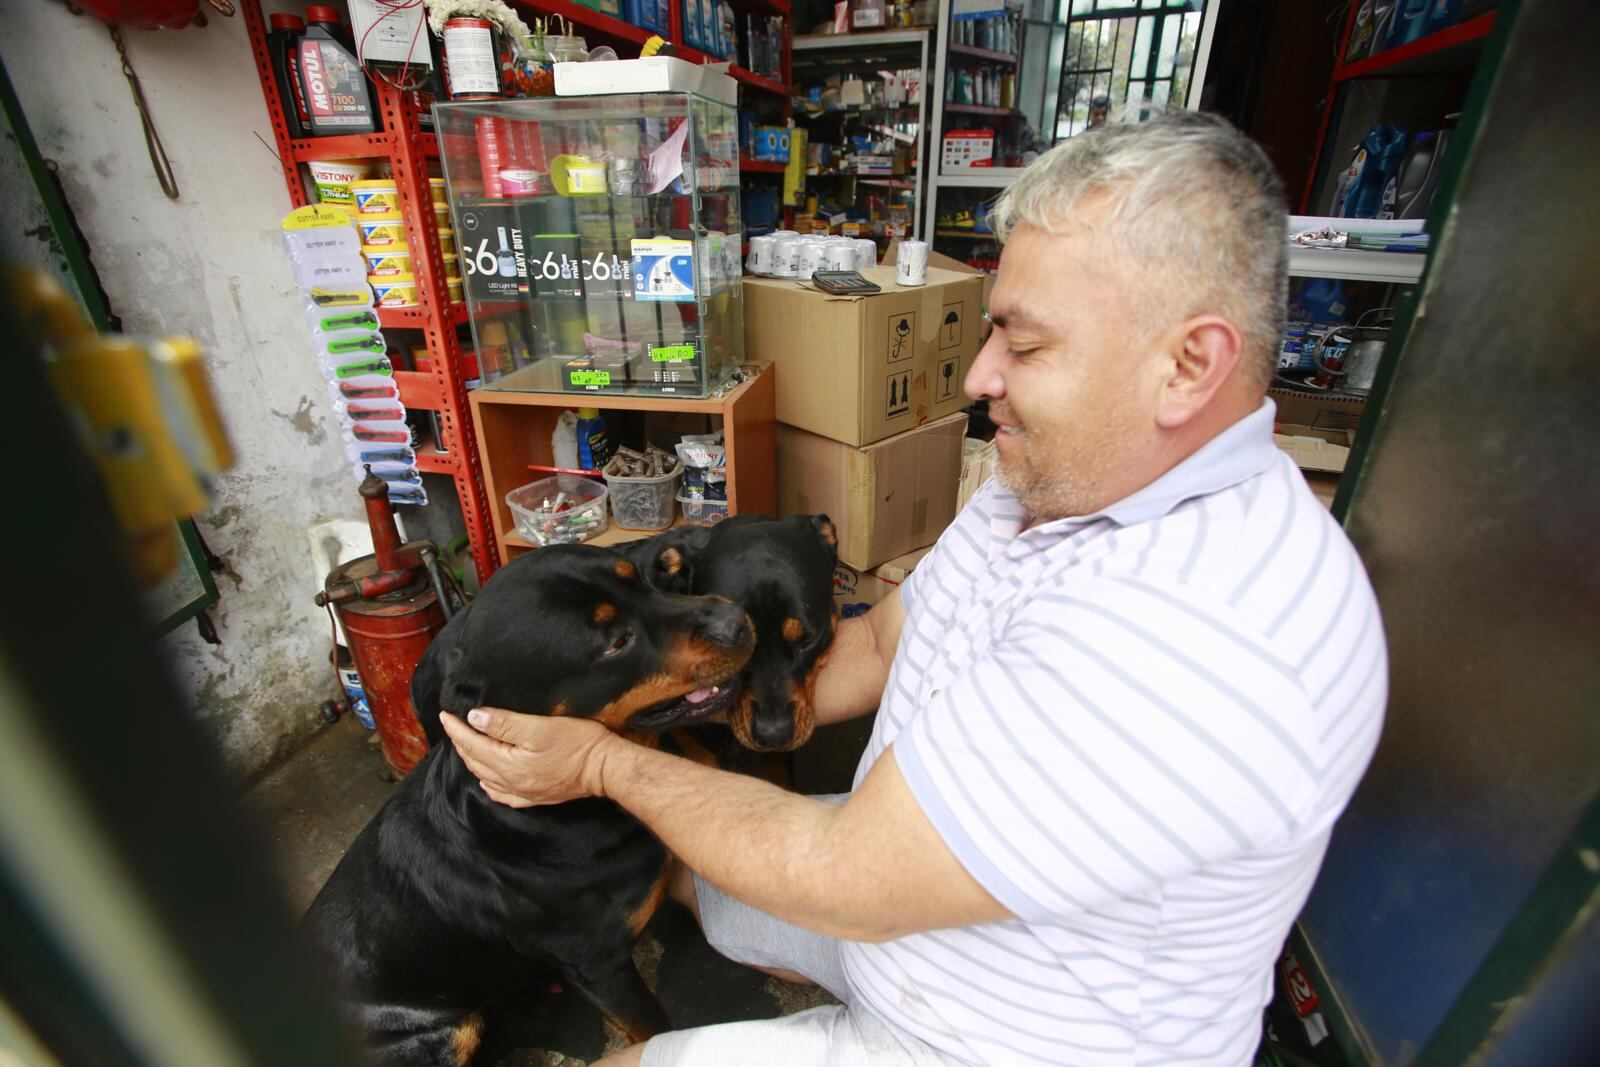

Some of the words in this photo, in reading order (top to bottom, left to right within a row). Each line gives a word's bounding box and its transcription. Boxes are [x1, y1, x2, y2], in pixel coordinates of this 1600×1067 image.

[303, 50, 330, 112] MOTUL
[330, 95, 355, 105] 7100
[314, 171, 355, 182] VISTONY
[296, 214, 319, 223] CUTTER
[510, 227, 525, 251] DUTY
[514, 251, 528, 278] HEAVY
[569, 260, 580, 280] mini
[620, 260, 632, 280] mini
[499, 282, 511, 290] Light
